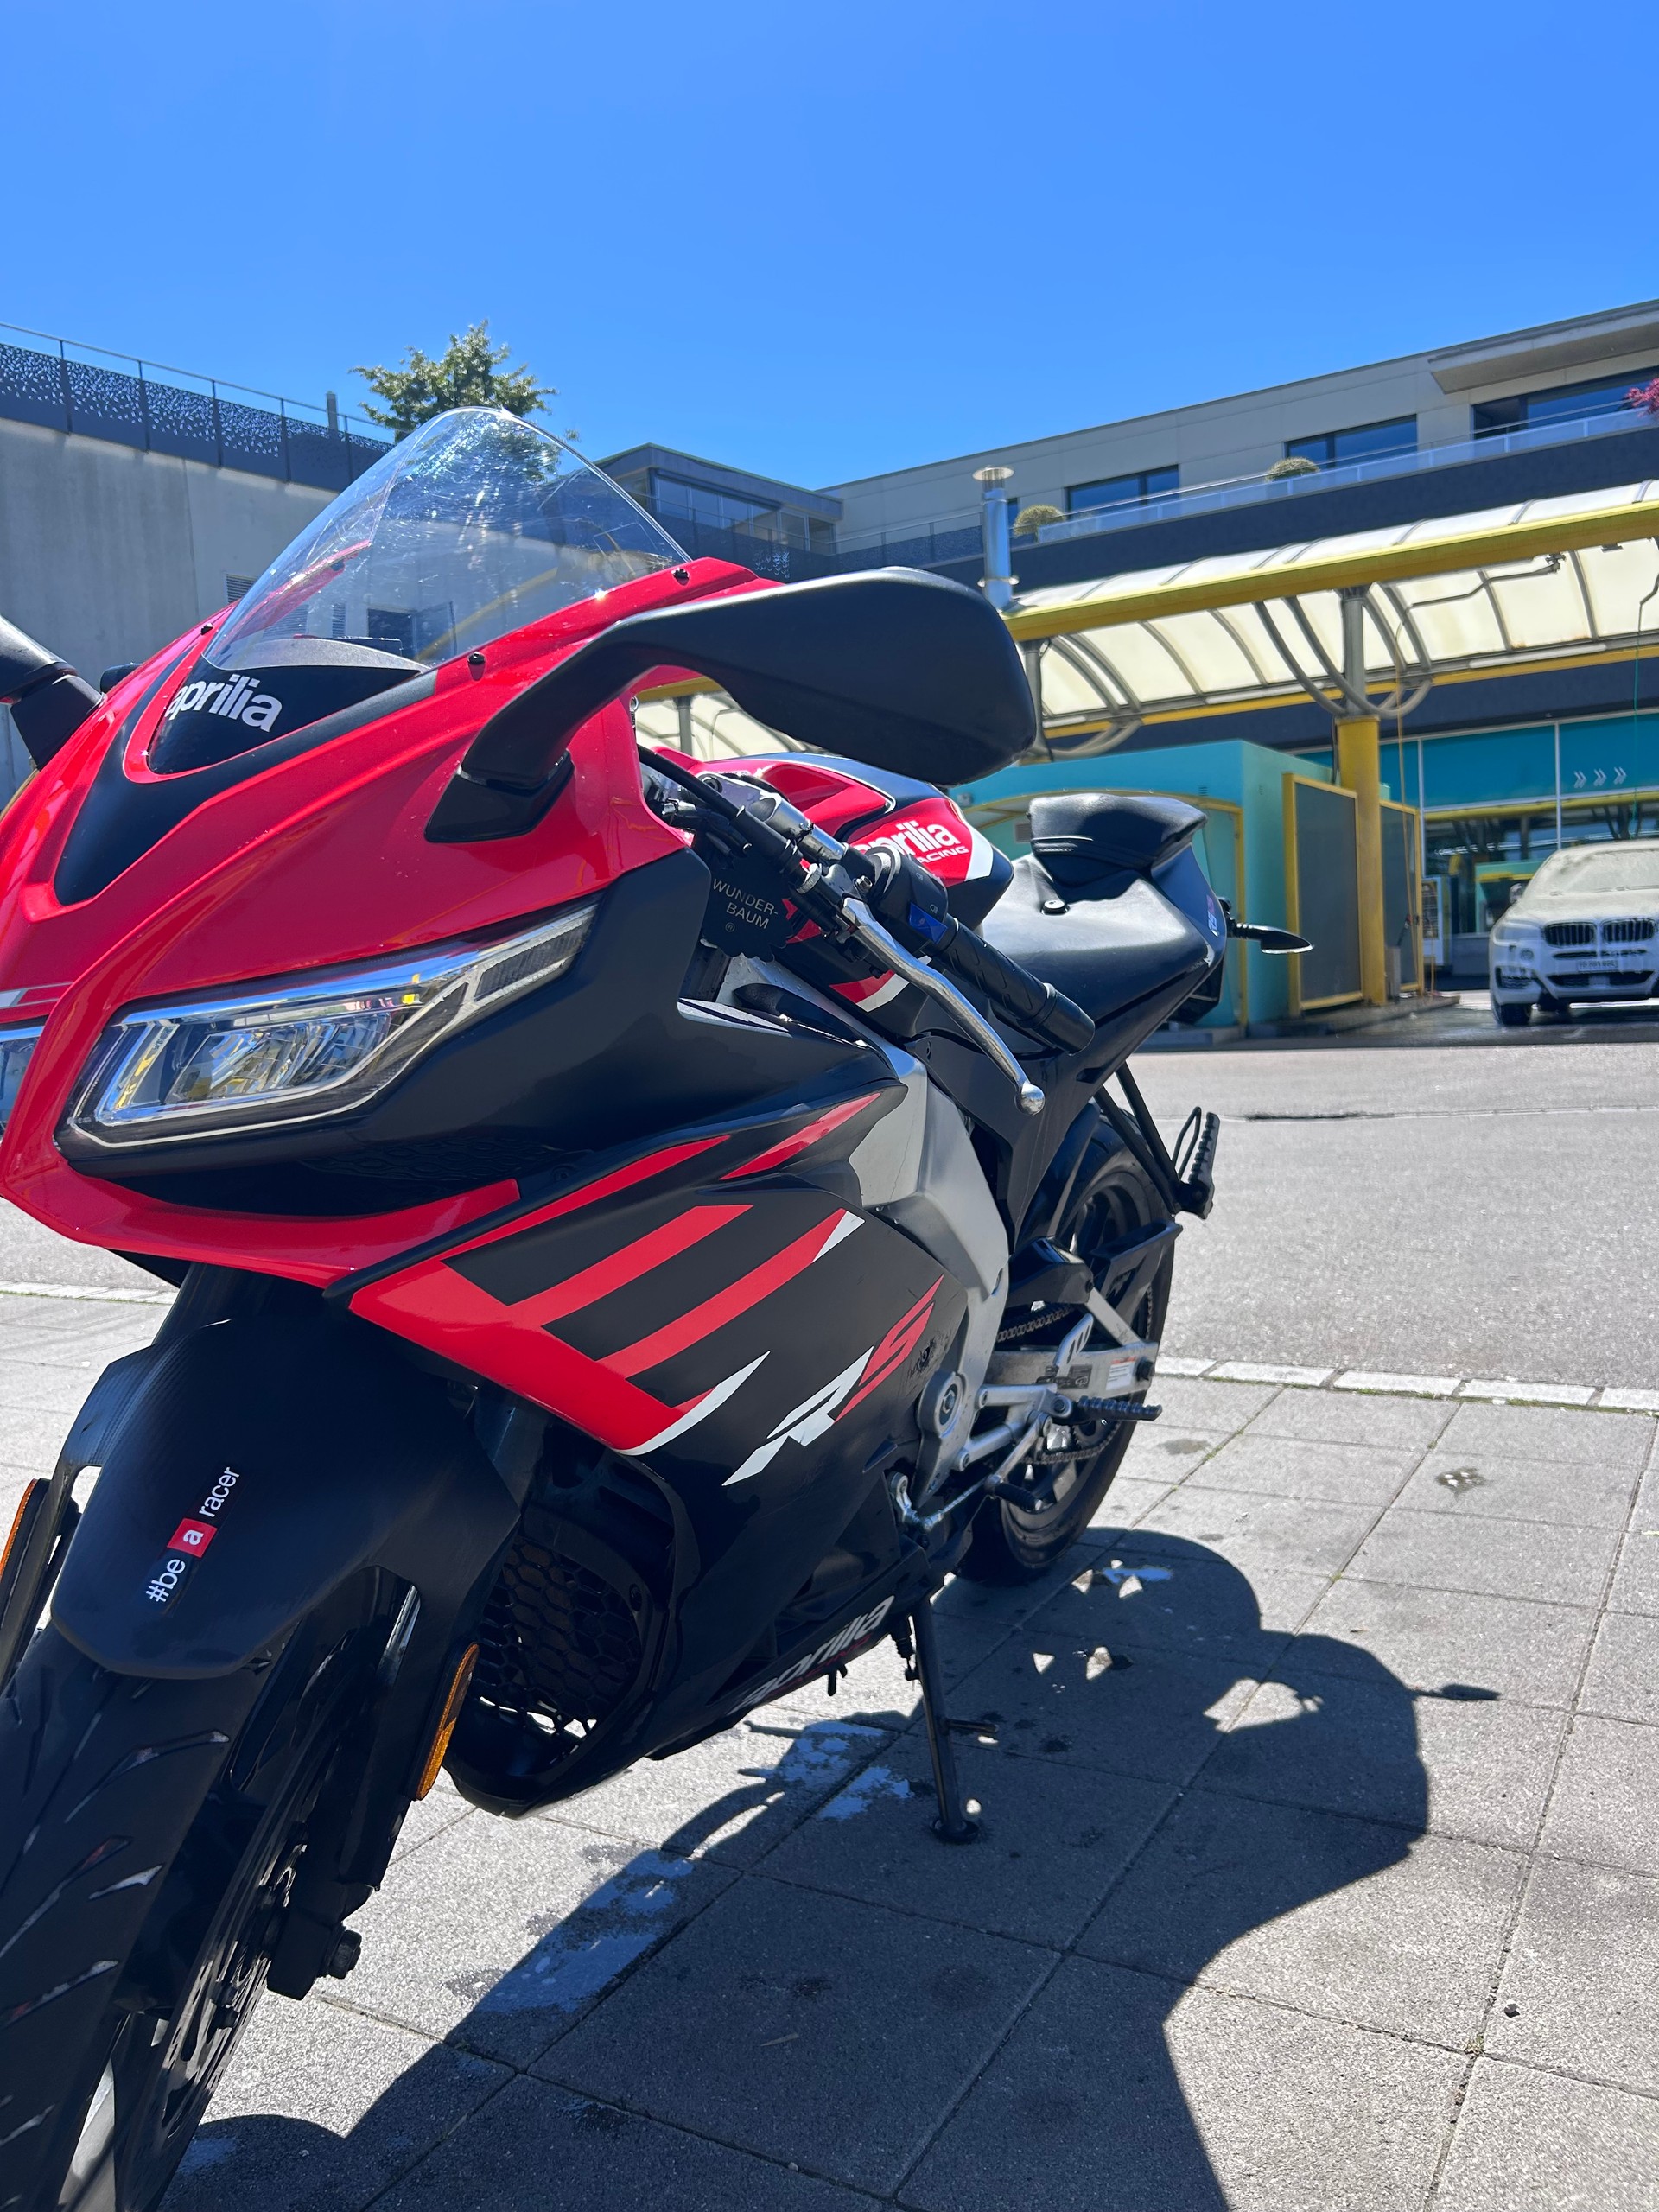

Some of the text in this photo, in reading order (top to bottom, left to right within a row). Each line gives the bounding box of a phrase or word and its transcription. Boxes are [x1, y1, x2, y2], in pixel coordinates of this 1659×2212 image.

[164, 673, 283, 733] aprilia
[915, 845, 969, 864] ACING
[713, 878, 779, 915] WUNDER-
[726, 902, 769, 930] BAUM
[145, 1466, 240, 1603] #be a racer
